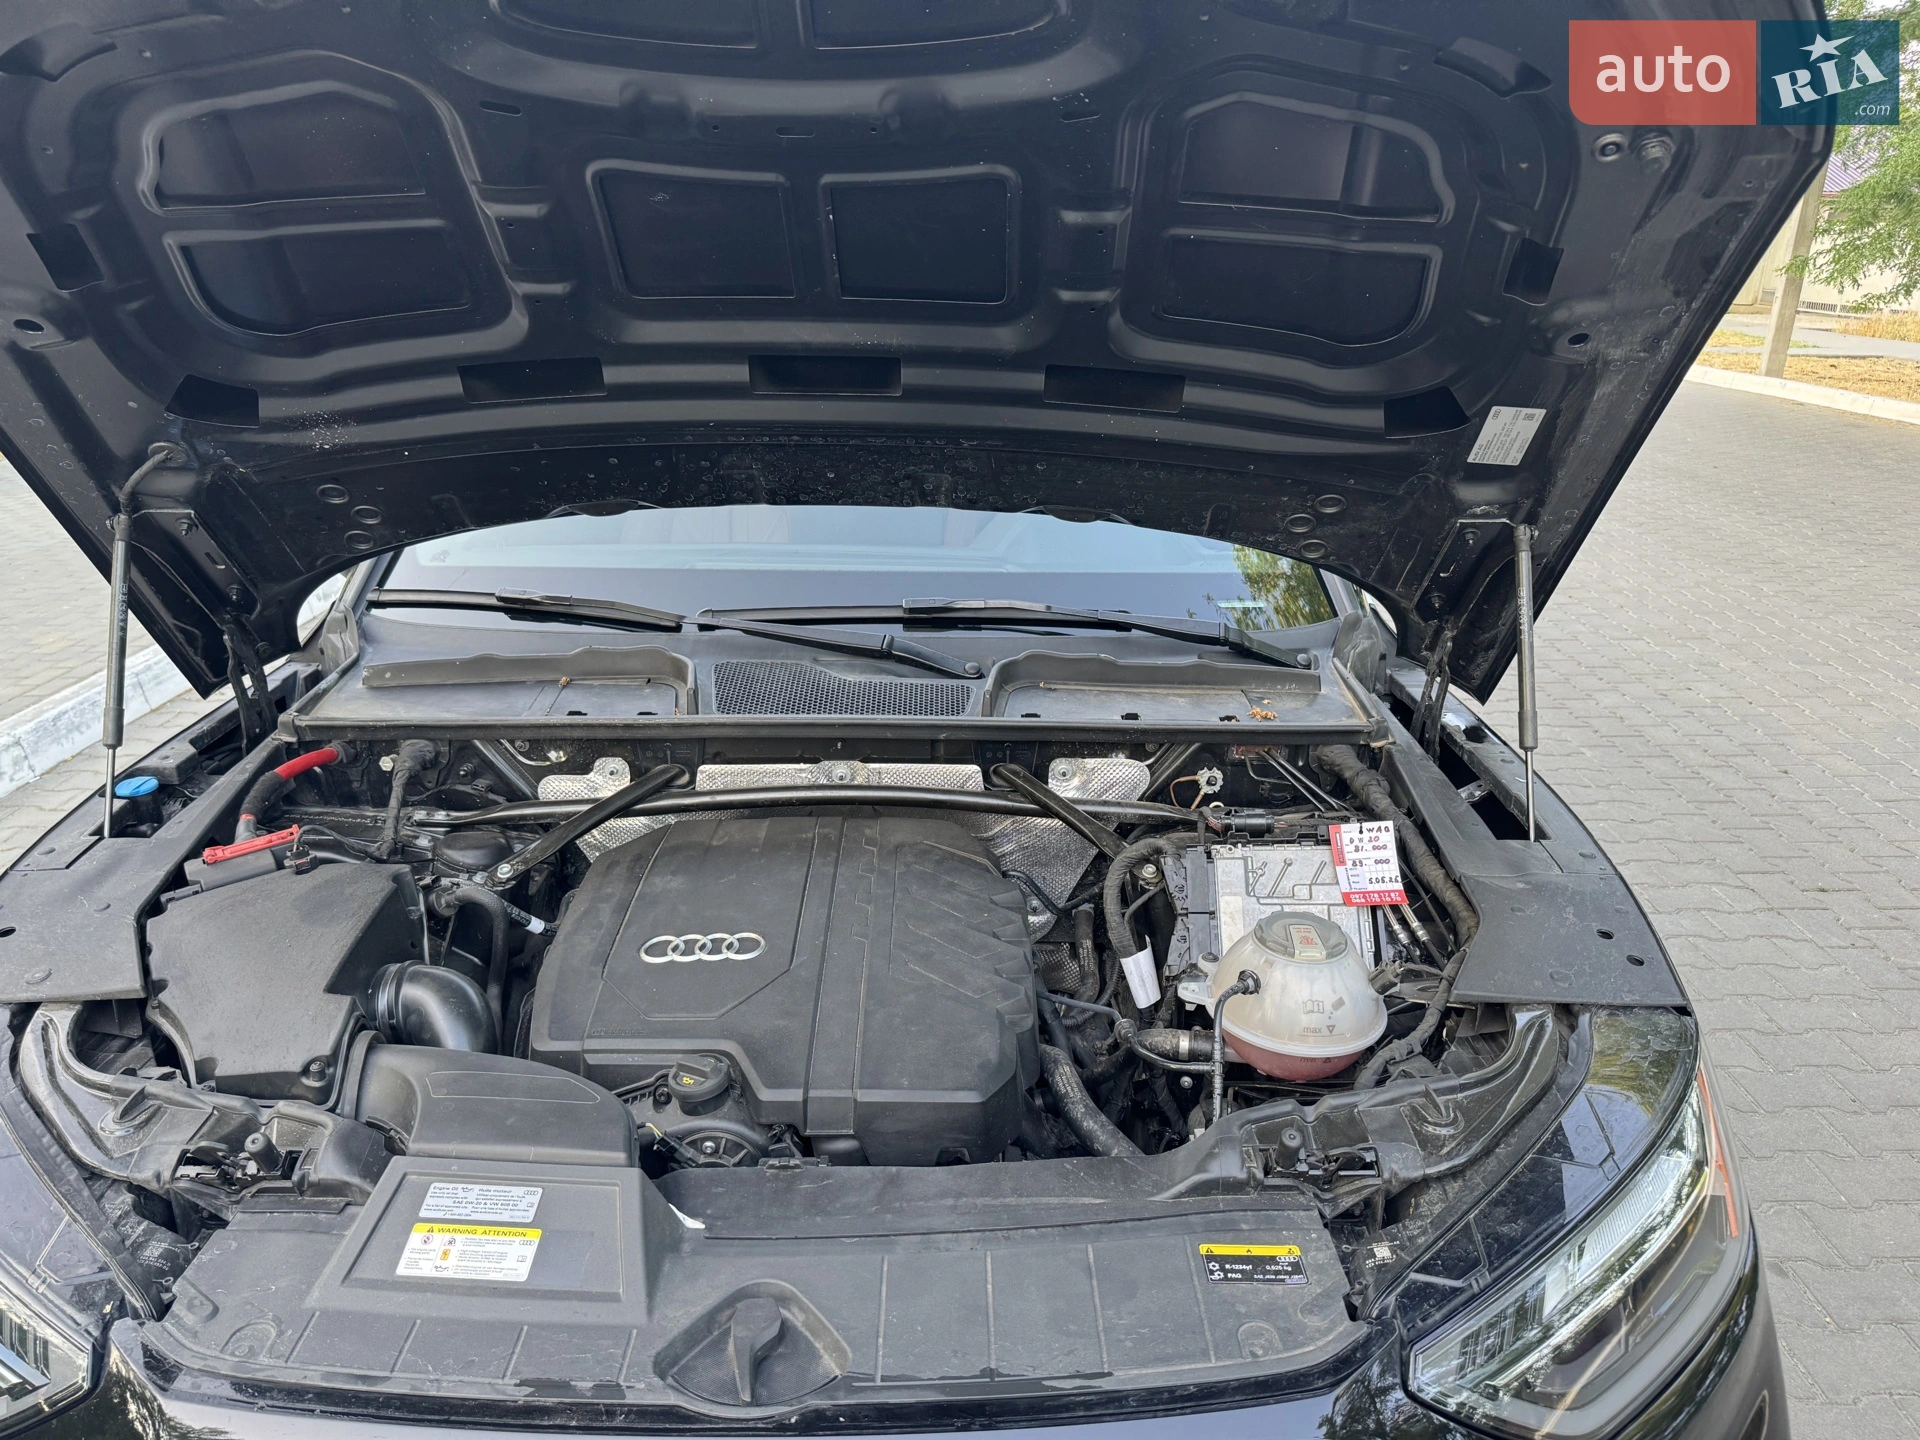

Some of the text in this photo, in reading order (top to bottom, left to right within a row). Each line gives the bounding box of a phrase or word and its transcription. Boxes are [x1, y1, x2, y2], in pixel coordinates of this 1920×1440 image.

[1303, 1026, 1323, 1034] max
[437, 1227, 528, 1237] WARNING ATTENTION
